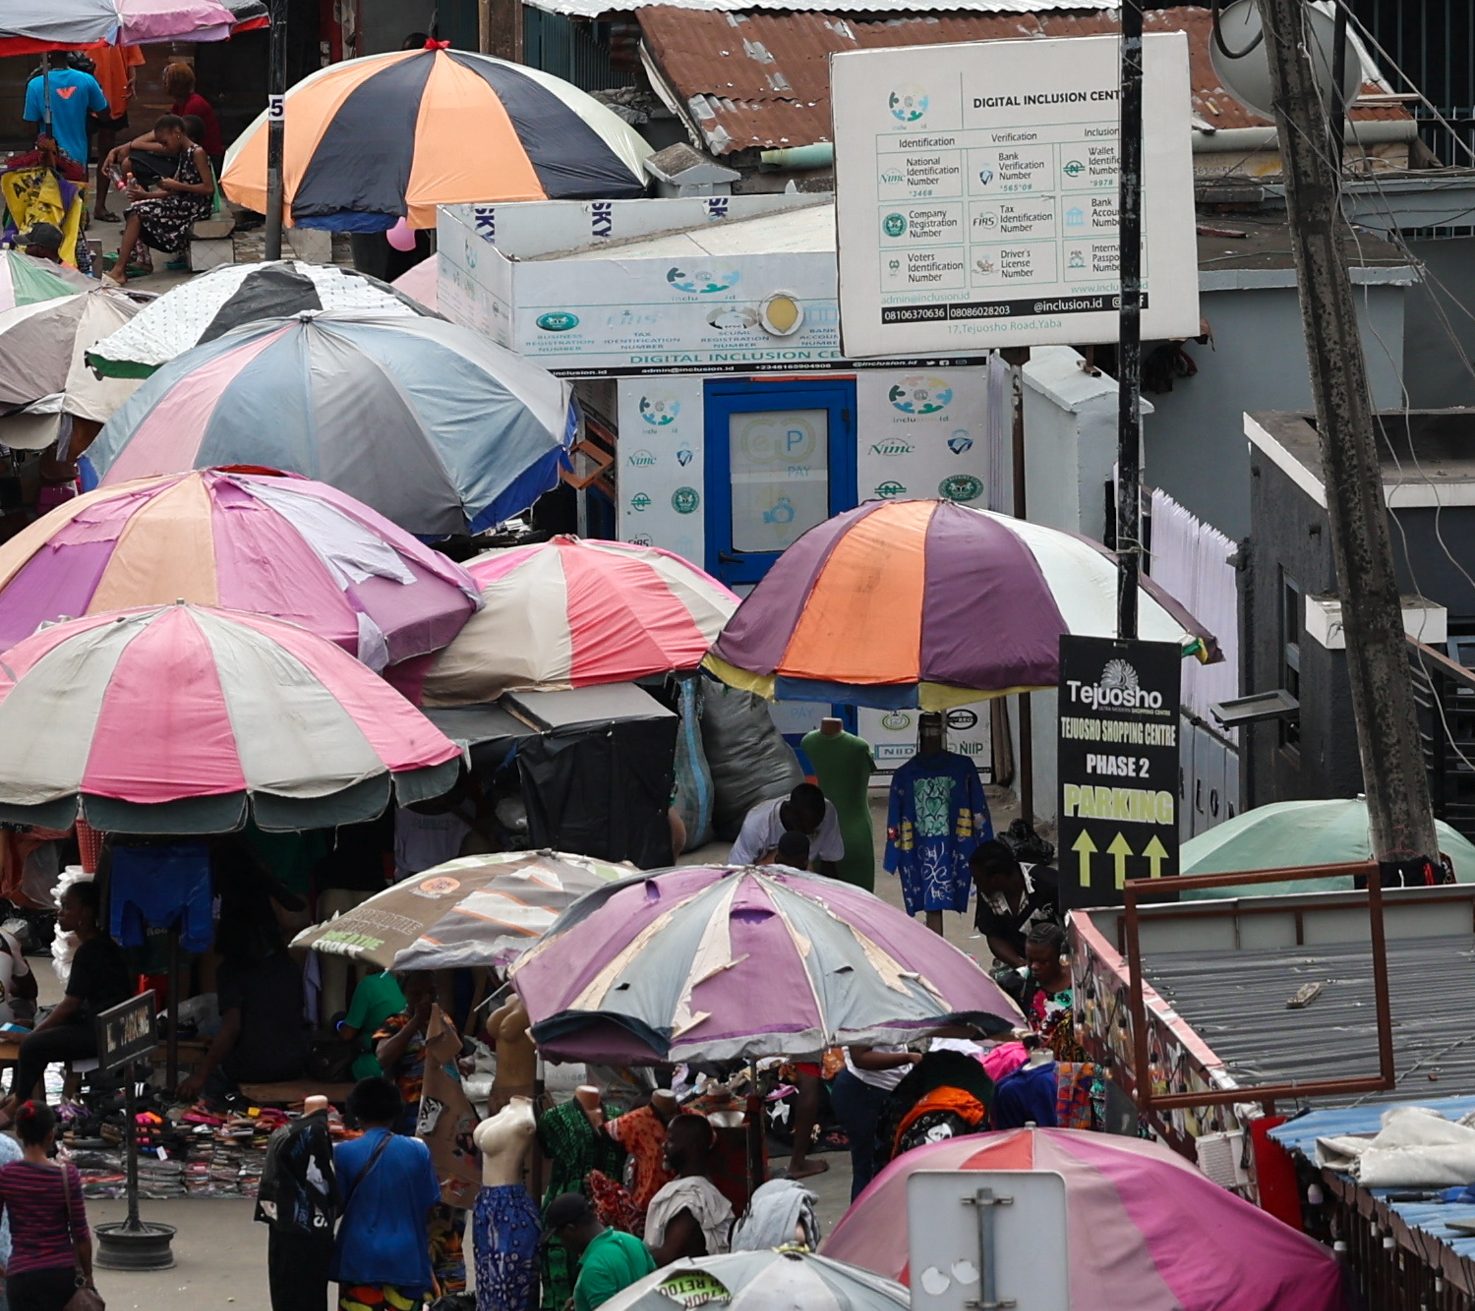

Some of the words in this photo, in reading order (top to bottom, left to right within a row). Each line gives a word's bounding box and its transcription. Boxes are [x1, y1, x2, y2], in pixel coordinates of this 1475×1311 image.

[973, 95, 1020, 109] DIGITAL
[1023, 92, 1087, 106] INCLUSION
[1090, 89, 1121, 102] CENT
[899, 137, 955, 149] Identification
[991, 132, 1037, 142] Verification
[1084, 127, 1120, 137] Inclusion
[999, 152, 1019, 161] Bank
[1088, 146, 1114, 156] Wallet
[906, 156, 941, 166] National
[999, 160, 1045, 171] Verification
[1088, 155, 1121, 166] Identific
[907, 165, 960, 176] Identification
[999, 170, 1031, 181] Number
[1088, 165, 1120, 176] Numbe
[907, 175, 939, 186] Number
[1091, 197, 1112, 207] Bank
[1000, 205, 1014, 213] Tax
[1091, 207, 1120, 218] Accou
[909, 210, 947, 221] Company
[1000, 212, 1053, 224] Identification
[909, 218, 957, 230] Registration
[1000, 223, 1033, 233] Number
[909, 229, 942, 239] Number
[908, 251, 935, 262] Voters
[1000, 249, 1031, 259] Driver's
[1092, 253, 1120, 264] Passpo
[908, 261, 963, 272] Identification
[1001, 258, 1031, 269] License
[908, 272, 942, 283] Number
[1001, 268, 1034, 278] Number
[1033, 298, 1103, 313] @inclusion.id
[884, 307, 945, 321] 08106370636
[950, 305, 1011, 318] 08086028203
[630, 354, 703, 364] DIGITAL
[709, 351, 816, 362] INCLUSION
[1067, 680, 1162, 710] Tejuosho
[1061, 717, 1100, 740] TEJUOSHO
[1102, 720, 1143, 745] SHOPPING
[1145, 724, 1176, 746] CENTRE
[1086, 754, 1136, 777] PHASE
[1139, 758, 1149, 778] 2
[1064, 783, 1174, 825] PARKING
